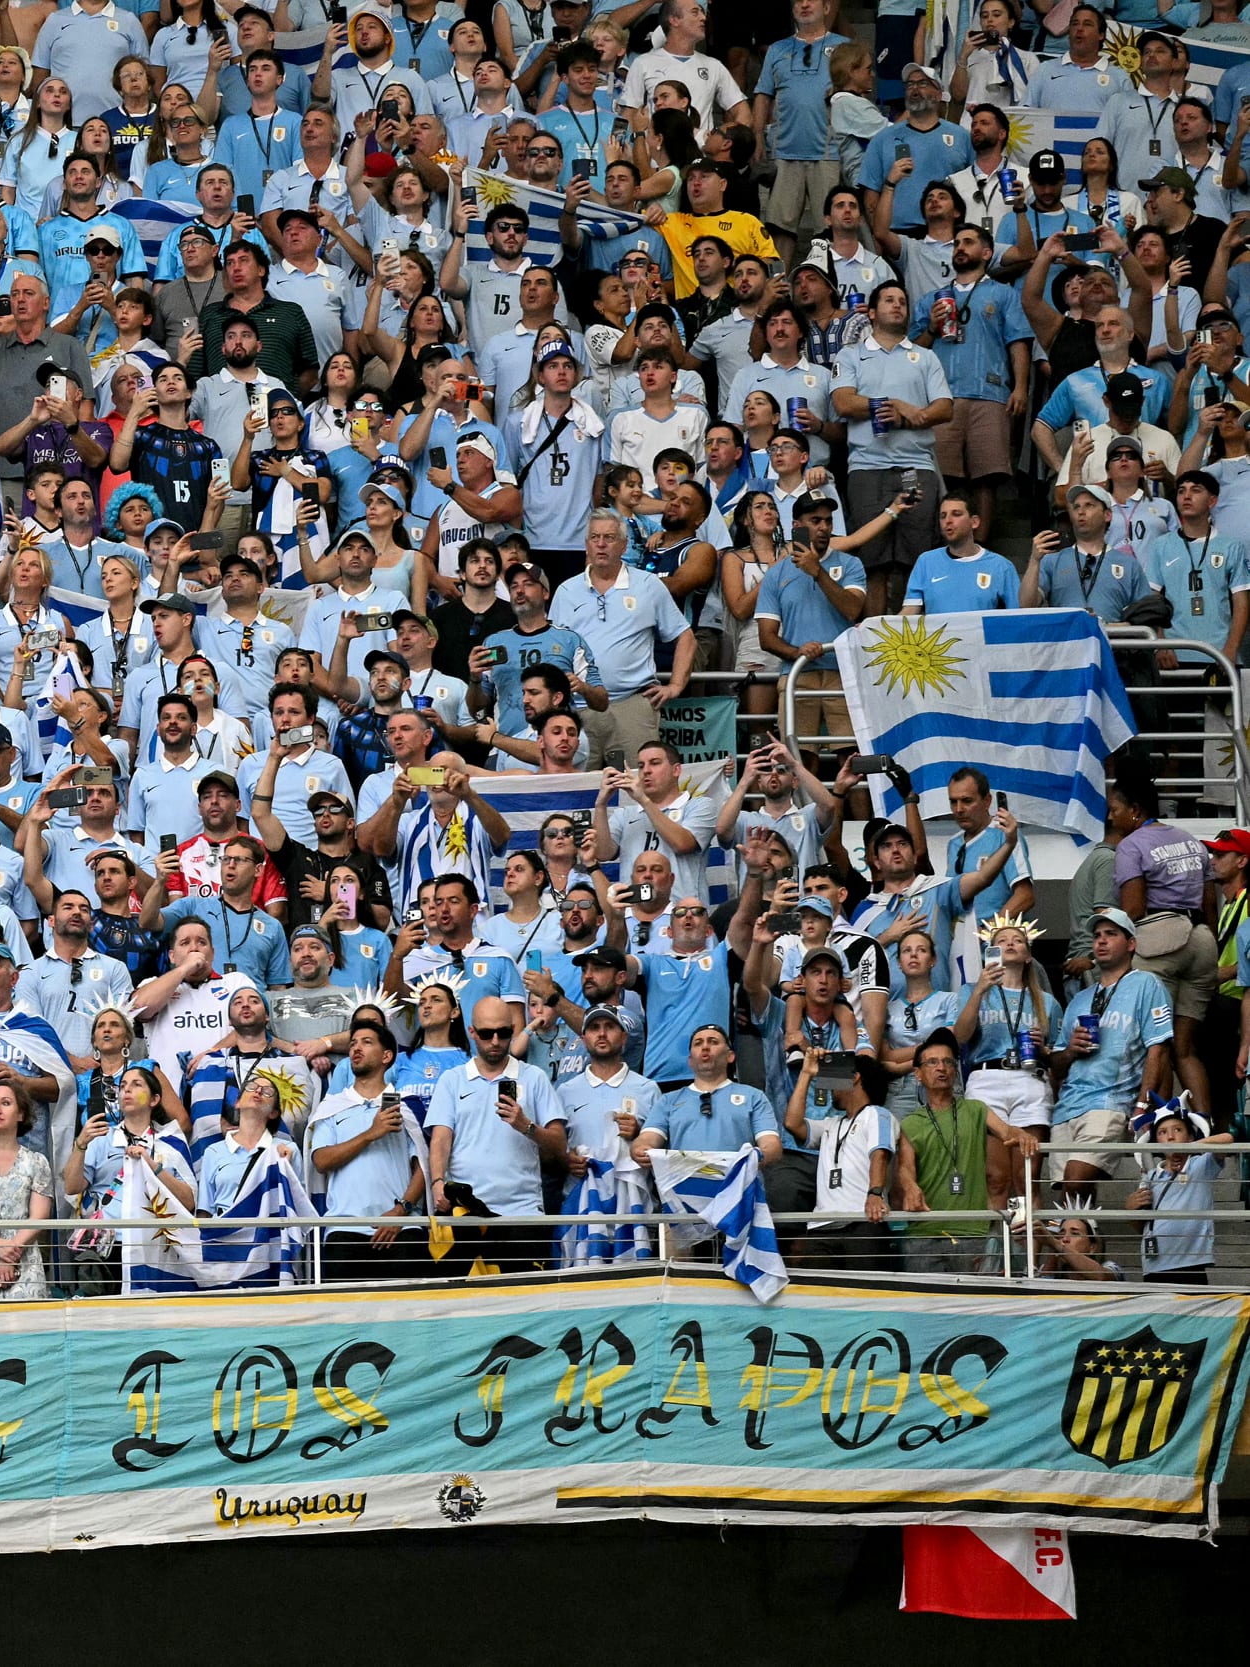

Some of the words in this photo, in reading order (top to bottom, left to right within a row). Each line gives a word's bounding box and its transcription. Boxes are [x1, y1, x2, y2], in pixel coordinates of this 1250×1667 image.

[494, 294, 510, 315] 15
[173, 480, 191, 503] 15
[235, 649, 255, 668] 15
[519, 649, 541, 668] 10
[658, 707, 706, 722] AMOS
[657, 728, 706, 746] RRIBA
[1150, 843, 1186, 863] STADIUM
[174, 1011, 222, 1029] antel
[111, 1337, 398, 1474] LOS
[453, 1319, 1010, 1452] TRAPOS
[214, 1487, 368, 1527] Uruguay
